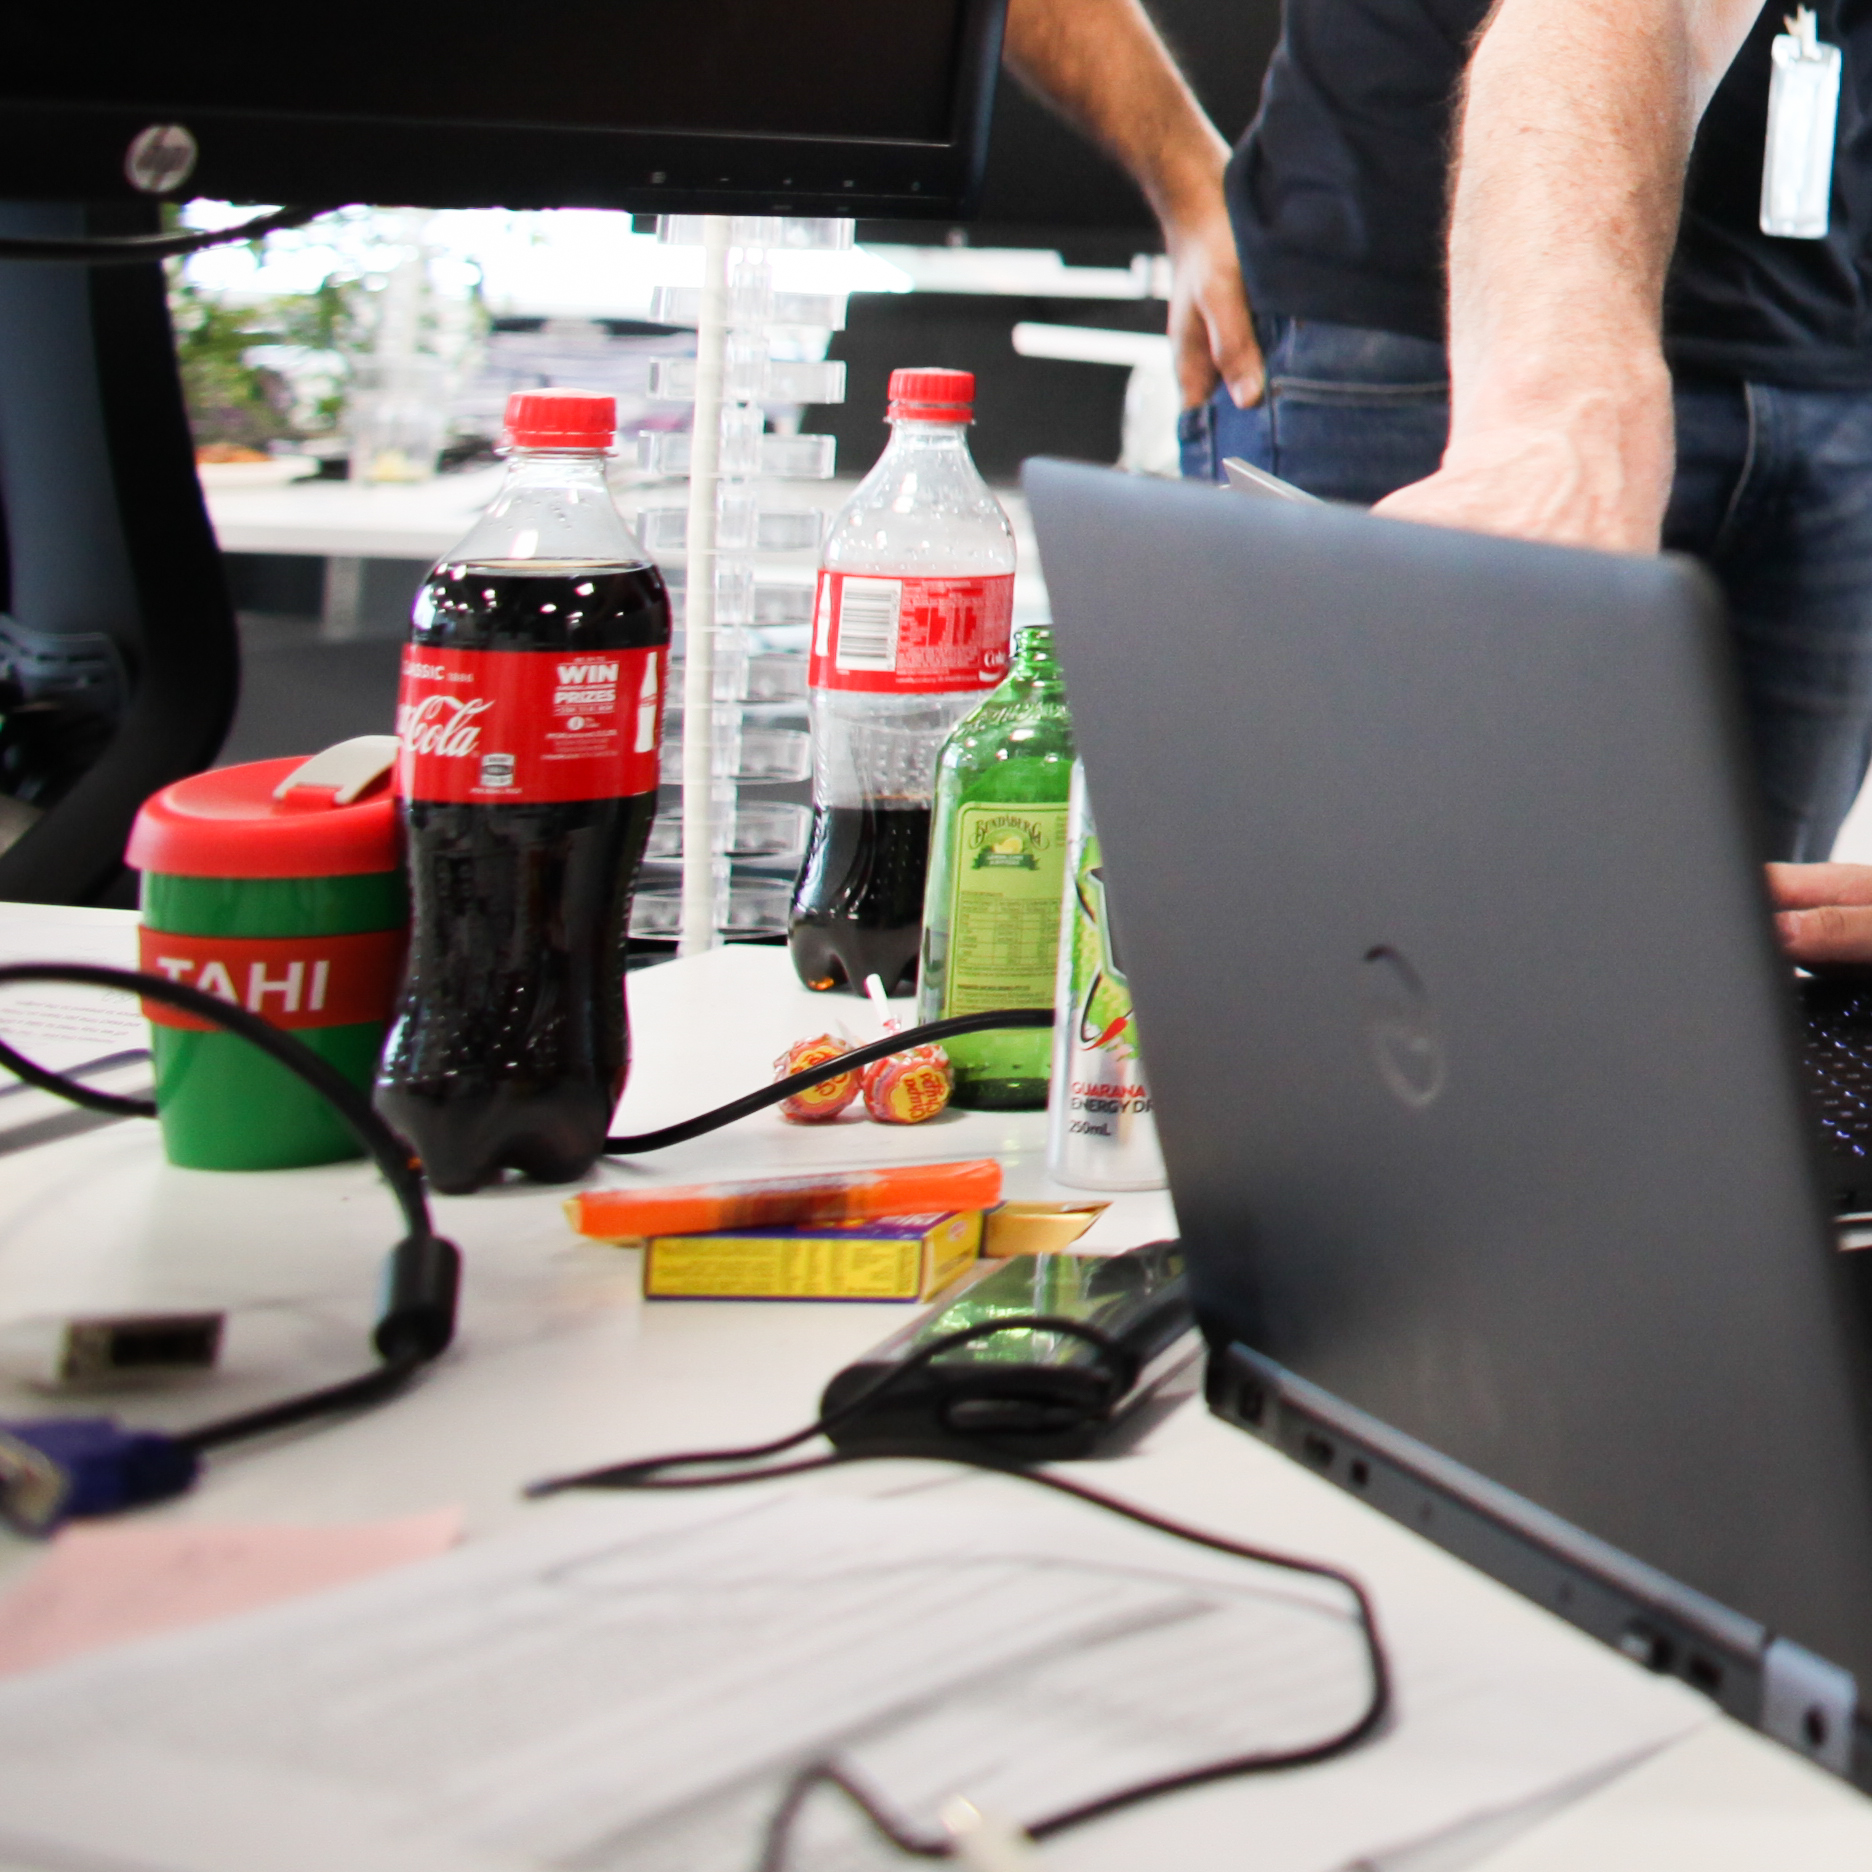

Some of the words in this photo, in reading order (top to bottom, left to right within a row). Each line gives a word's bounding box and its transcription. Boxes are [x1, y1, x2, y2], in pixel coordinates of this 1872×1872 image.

[557, 663, 620, 684] WIN
[553, 688, 617, 705] PRIZES
[157, 956, 330, 1013] TAHI
[1071, 1082, 1147, 1098] GUARANA
[1071, 1097, 1131, 1113] ENERGY
